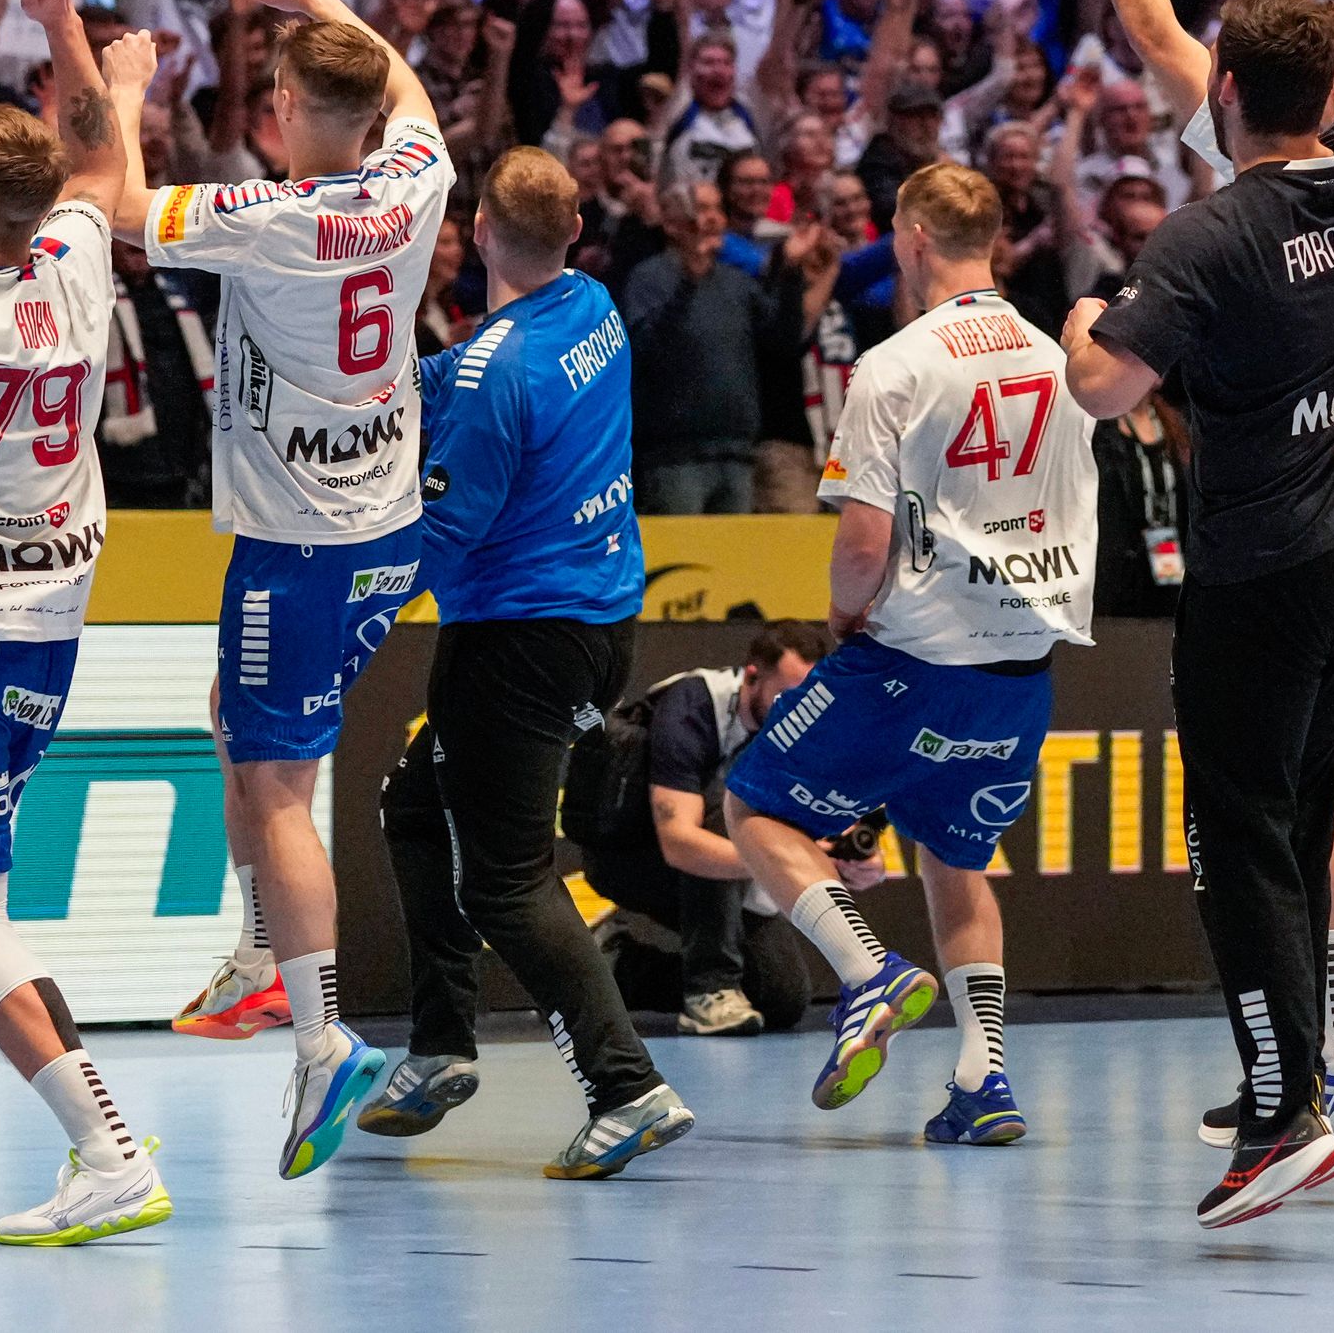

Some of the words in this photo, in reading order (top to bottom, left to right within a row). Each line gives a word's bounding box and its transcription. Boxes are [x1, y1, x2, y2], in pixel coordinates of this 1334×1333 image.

[315, 202, 413, 261] MORTENSEN
[14, 300, 59, 349] HORN
[338, 265, 395, 377] 6
[946, 371, 1058, 481] 47
[425, 476, 446, 492] sms
[984, 517, 1027, 534] SPORT
[883, 679, 908, 698] 47
